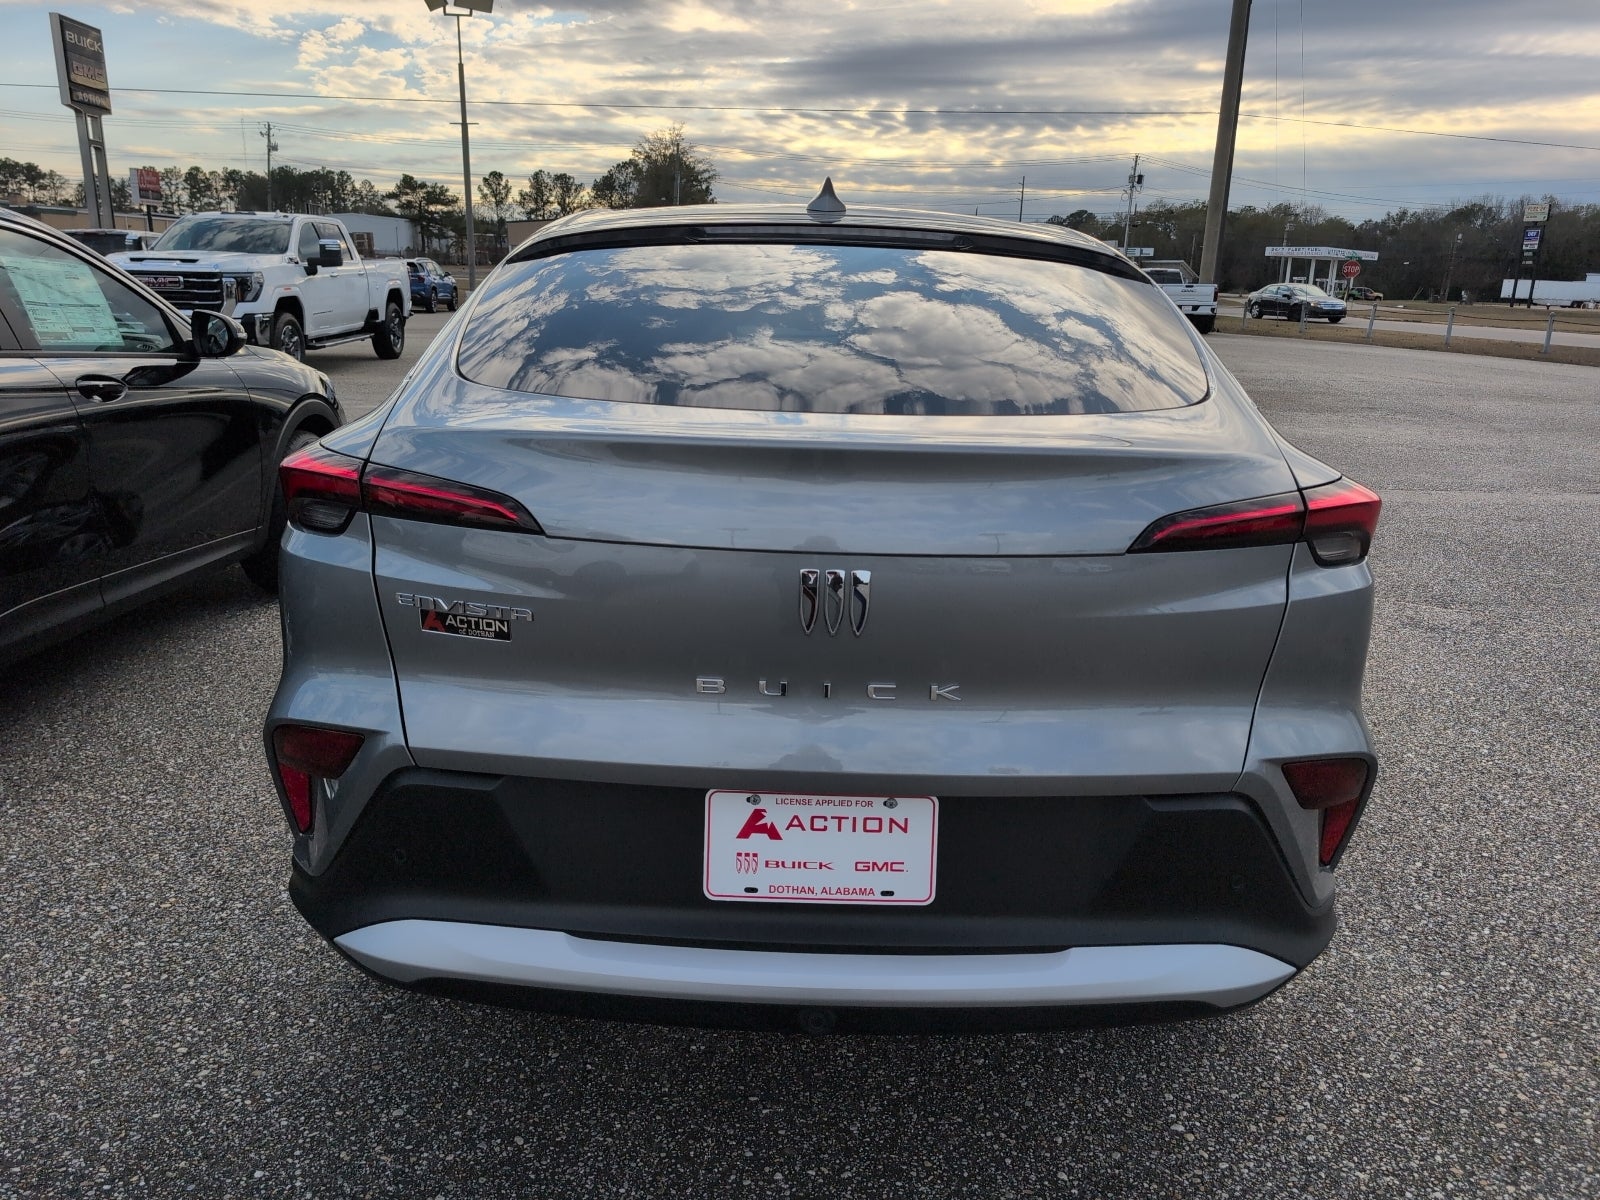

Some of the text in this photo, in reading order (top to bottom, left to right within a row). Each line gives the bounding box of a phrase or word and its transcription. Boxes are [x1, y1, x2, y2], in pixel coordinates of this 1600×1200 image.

[65, 30, 102, 53] BUICK
[72, 61, 104, 83] GMC
[1343, 265, 1360, 273] STOP
[396, 592, 534, 621] ENVISTA
[445, 615, 508, 633] ACTION
[468, 629, 495, 638] DOTHAN
[696, 678, 961, 700] BUICK
[775, 797, 874, 808] LICENSE APPLIED FOR
[785, 814, 909, 834] ACTION
[764, 860, 905, 873] BUICK GMC
[768, 885, 875, 897] DOTHAN, ALABAMA
